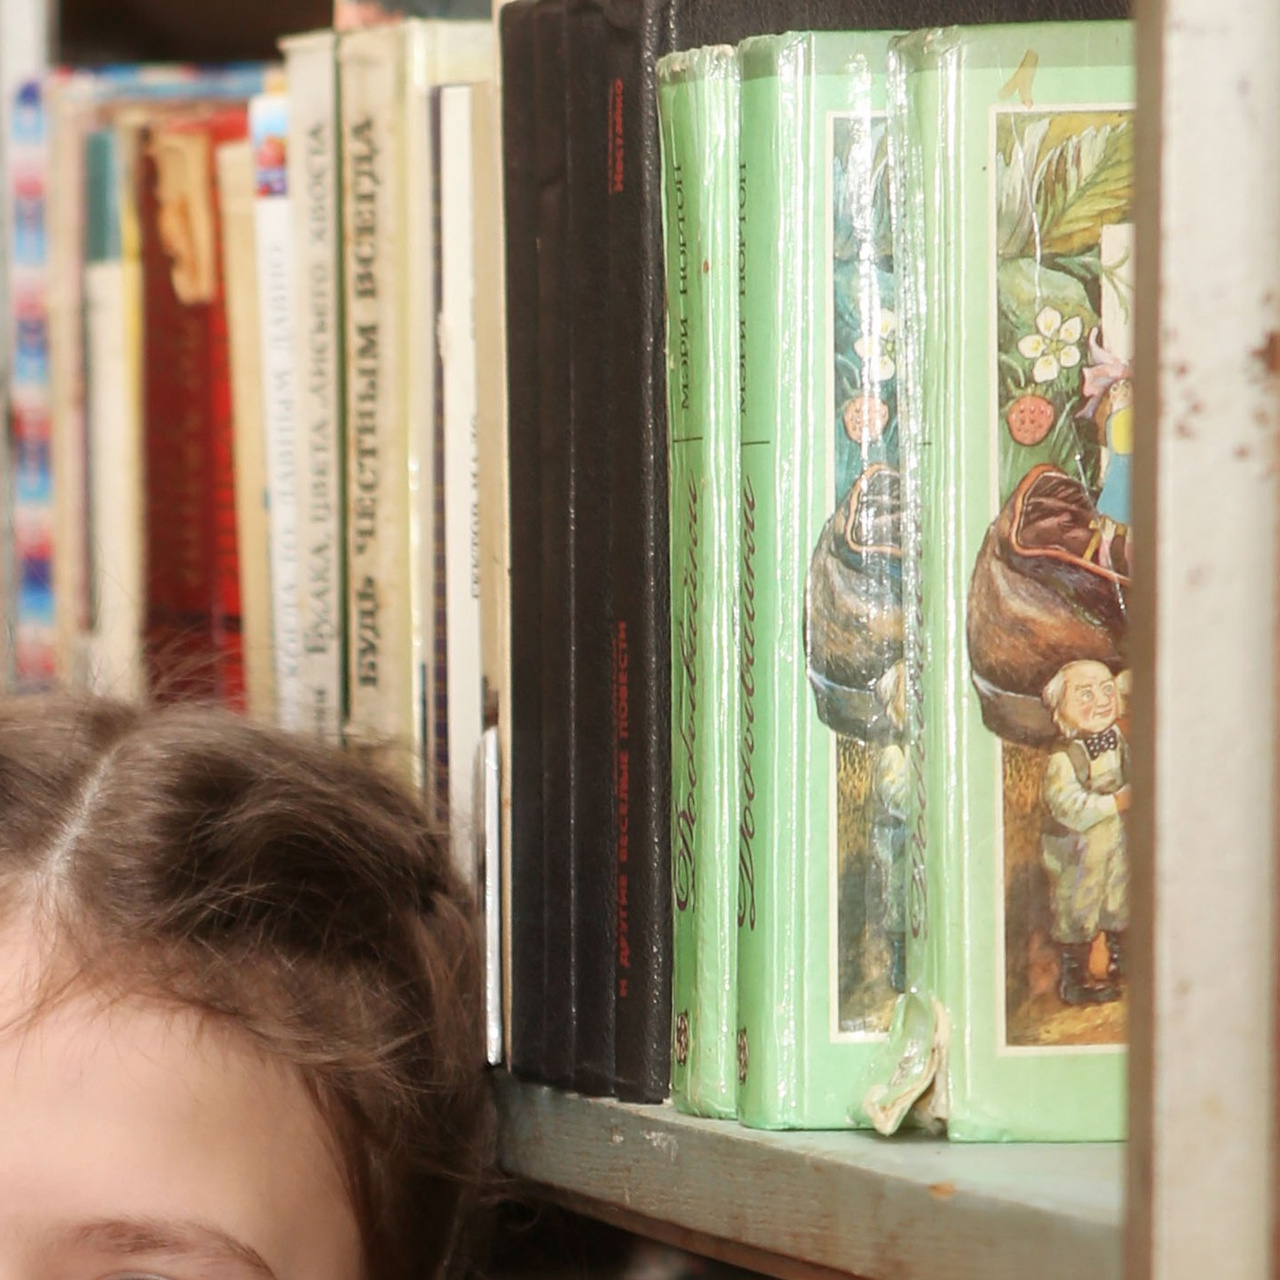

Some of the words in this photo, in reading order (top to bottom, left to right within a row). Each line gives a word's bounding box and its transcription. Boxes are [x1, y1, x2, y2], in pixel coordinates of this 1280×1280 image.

[350, 115, 381, 301] ВСЕГДА
[672, 165, 688, 296] НОРТОН
[678, 318, 690, 411] МЭРИ
[354, 322, 379, 555] ЧЕСТНЫМ
[357, 576, 380, 688] БУДЬ
